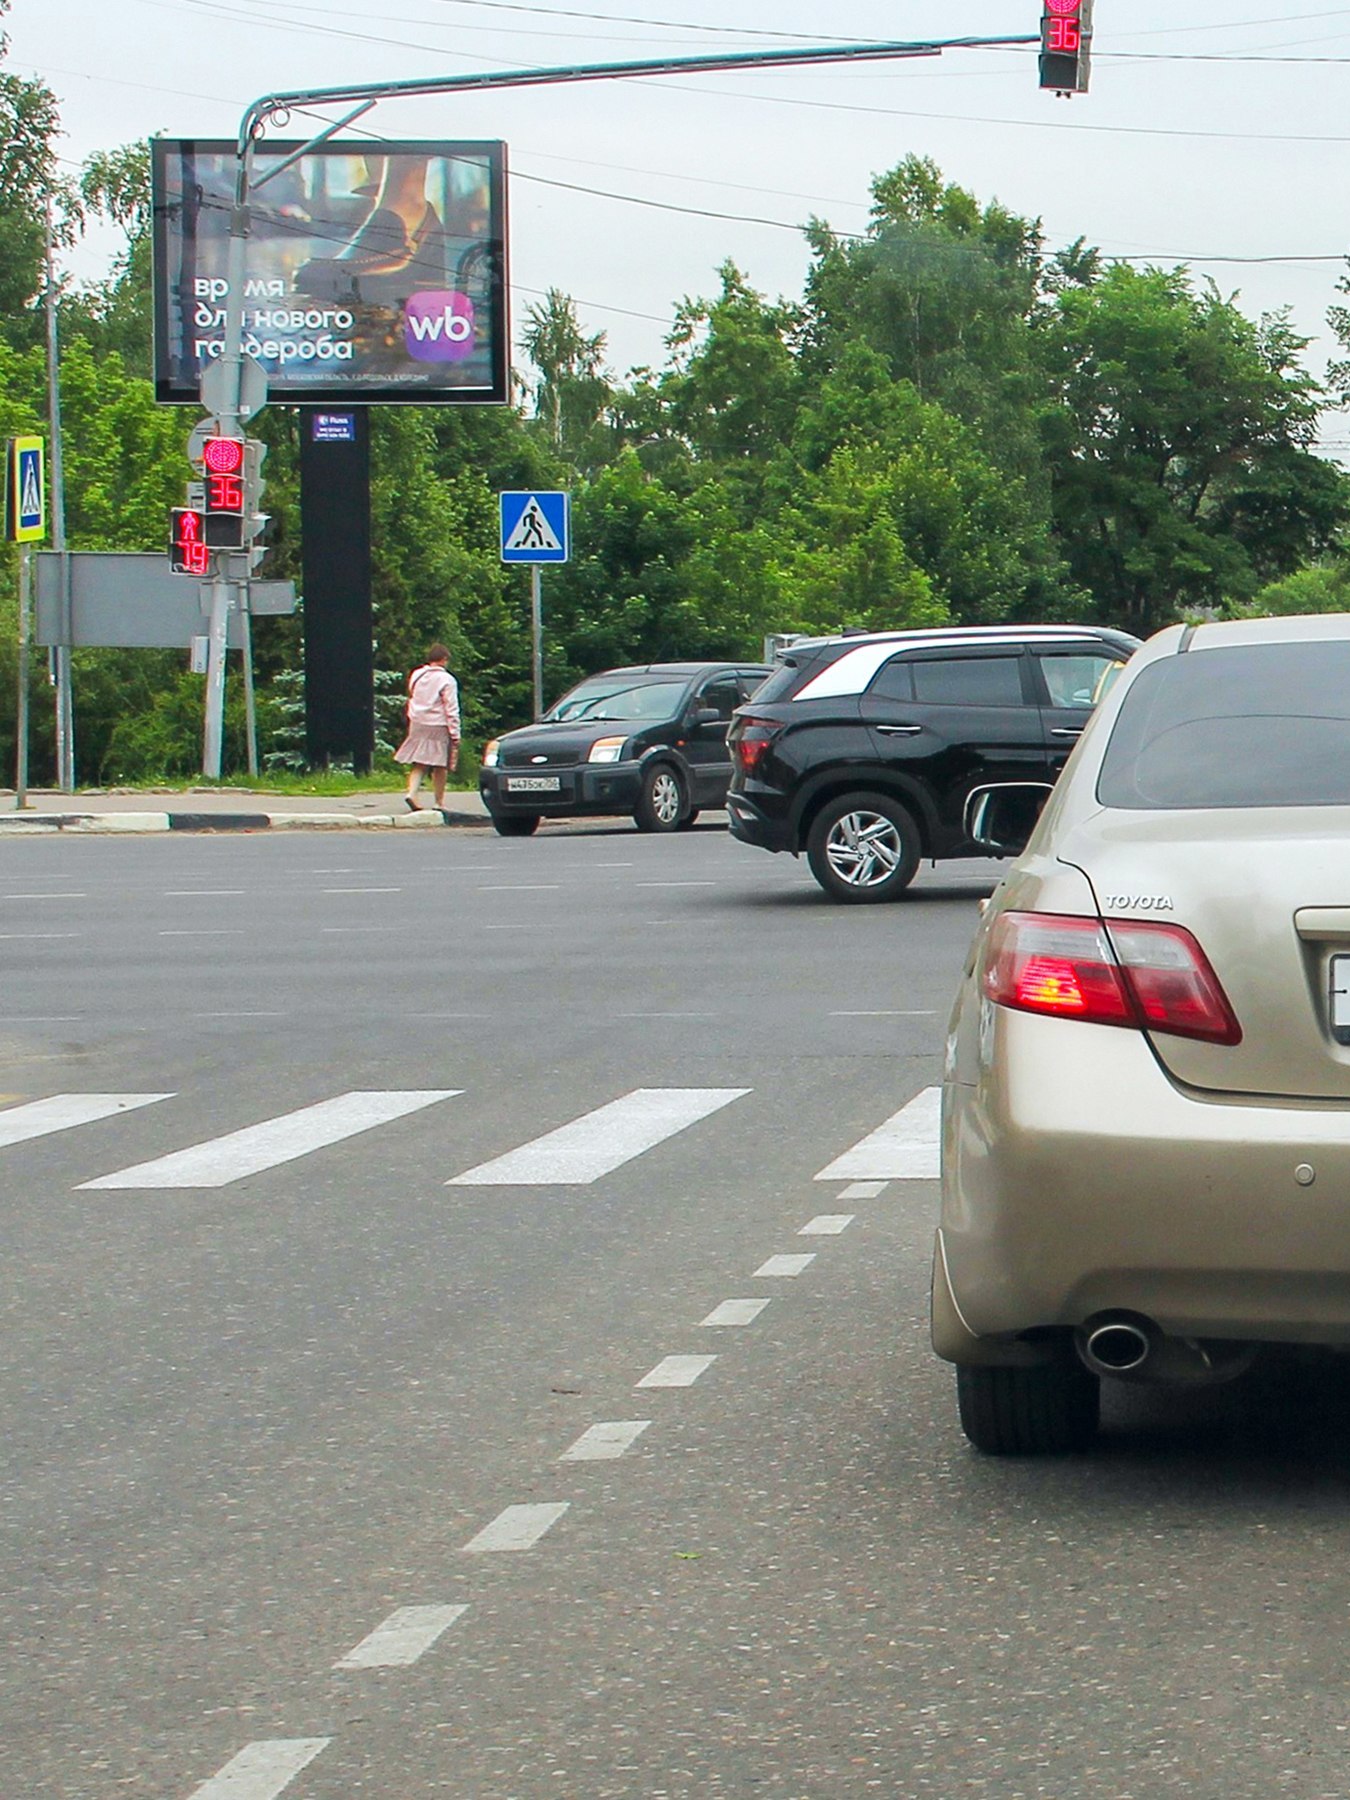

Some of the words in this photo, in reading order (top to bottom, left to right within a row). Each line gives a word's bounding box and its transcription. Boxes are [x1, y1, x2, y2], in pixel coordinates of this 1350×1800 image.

[1048, 18, 1078, 49] 36
[194, 278, 284, 302] врмя
[194, 302, 246, 328] дл
[254, 310, 354, 328] нового
[408, 305, 471, 341] wb
[194, 333, 353, 364] гадероба
[211, 477, 241, 507] 36
[1106, 894, 1173, 910] TOYOTA
